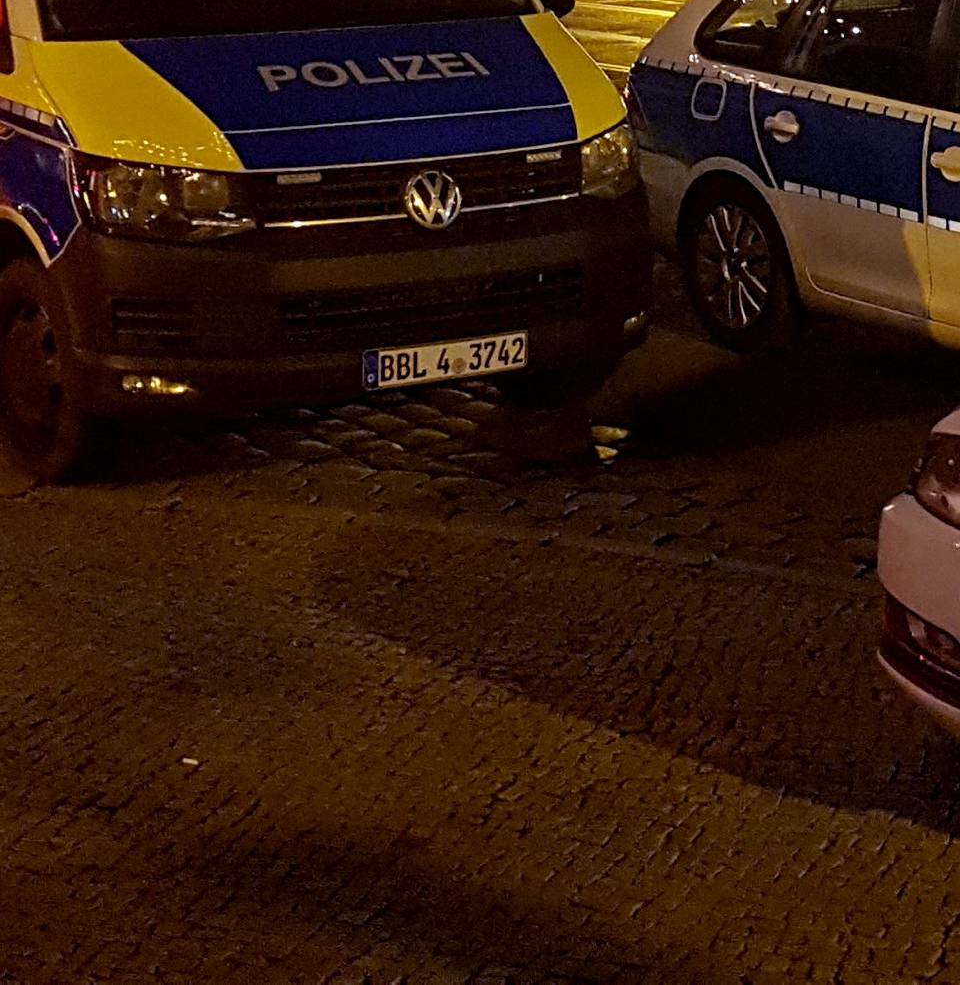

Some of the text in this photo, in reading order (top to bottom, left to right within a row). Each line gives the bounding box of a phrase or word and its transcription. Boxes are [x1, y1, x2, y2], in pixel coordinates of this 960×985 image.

[256, 51, 491, 93] POLIZEI
[380, 337, 525, 382] BBL 4 3742
